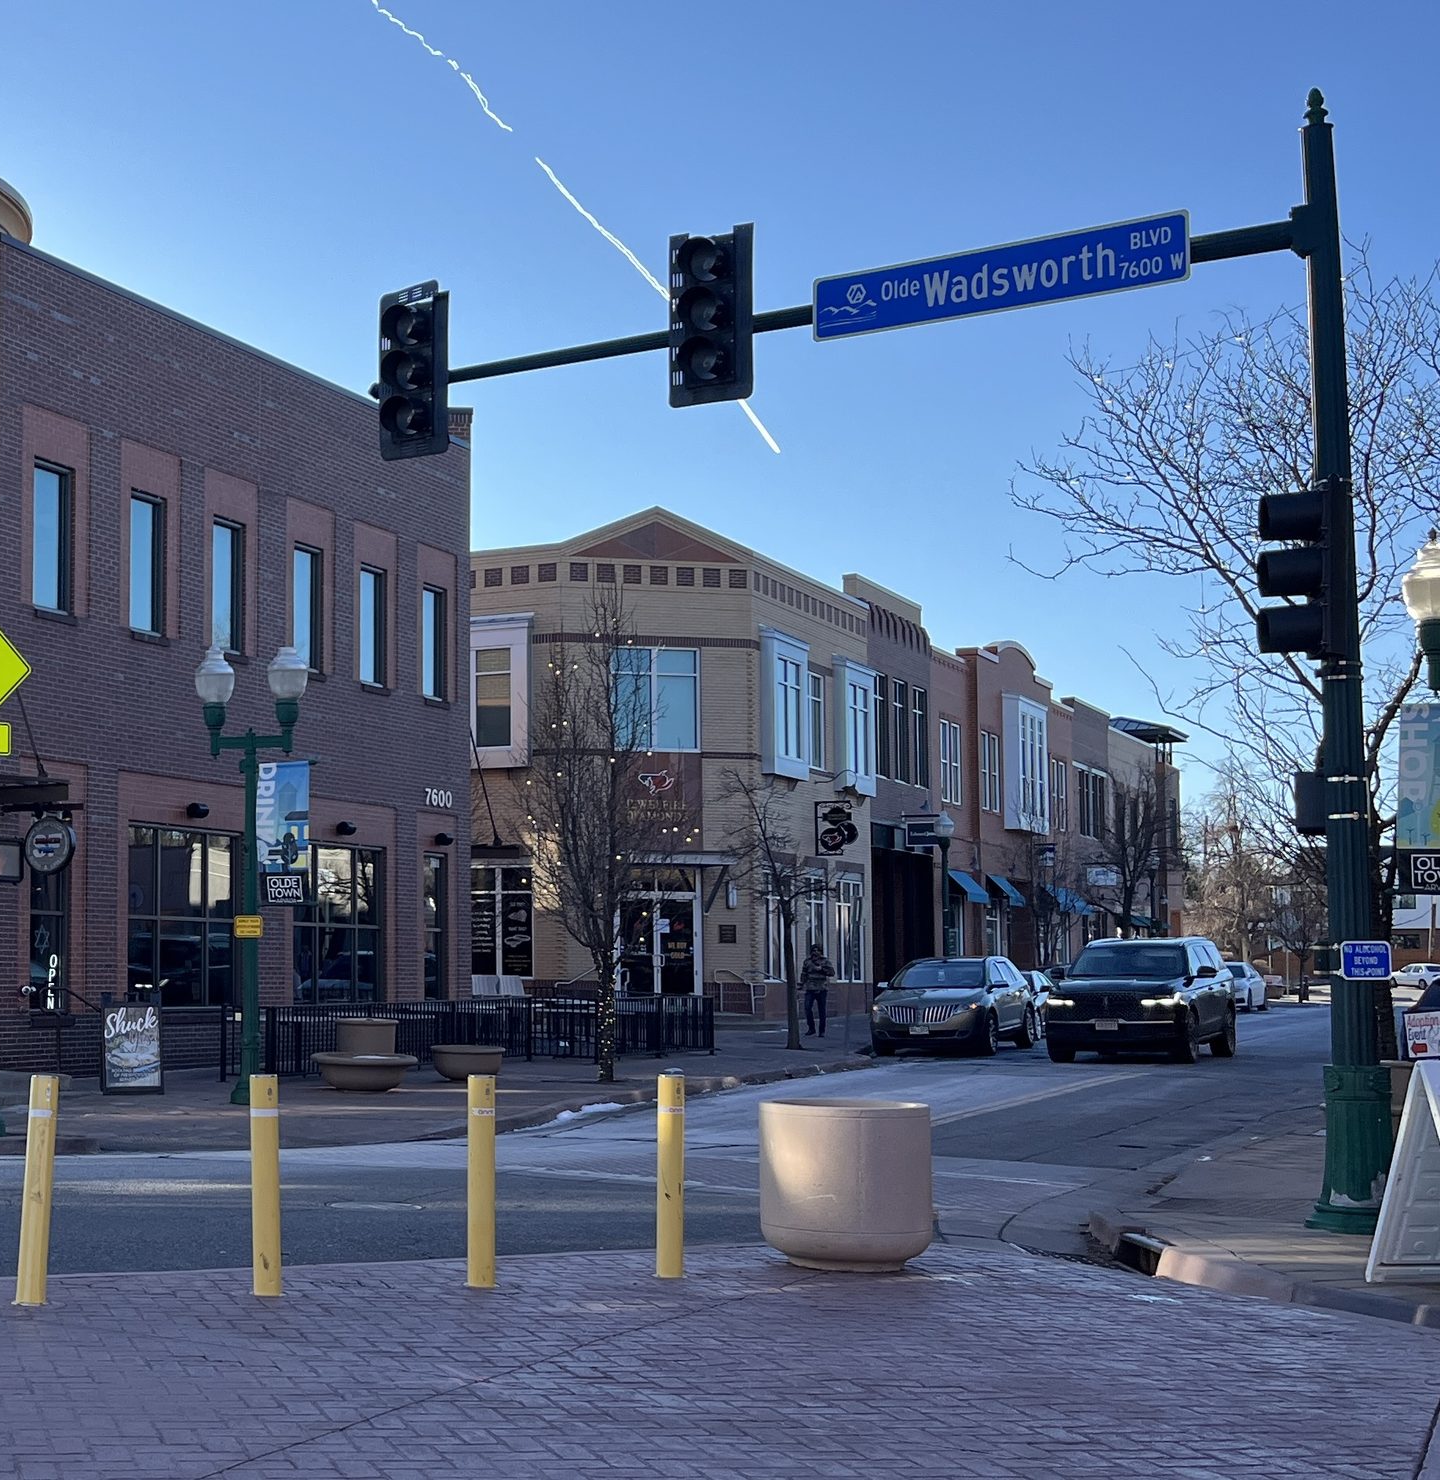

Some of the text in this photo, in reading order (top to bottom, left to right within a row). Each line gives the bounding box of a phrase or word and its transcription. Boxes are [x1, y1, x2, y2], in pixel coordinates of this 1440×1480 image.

[1130, 226, 1172, 250] BLVD
[880, 243, 1116, 307] Olde Wadsworth
[1119, 251, 1184, 280] 7600 W
[1401, 704, 1430, 808] SHOP
[425, 788, 453, 808] 7600
[270, 888, 300, 898] TOWN
[271, 879, 298, 888] OLDE
[1343, 945, 1353, 953] NO
[1351, 967, 1385, 976] THIS POINT
[1353, 956, 1378, 965] BEYOND
[47, 954, 58, 1009] OPEN
[104, 1006, 158, 1038] Shuck
